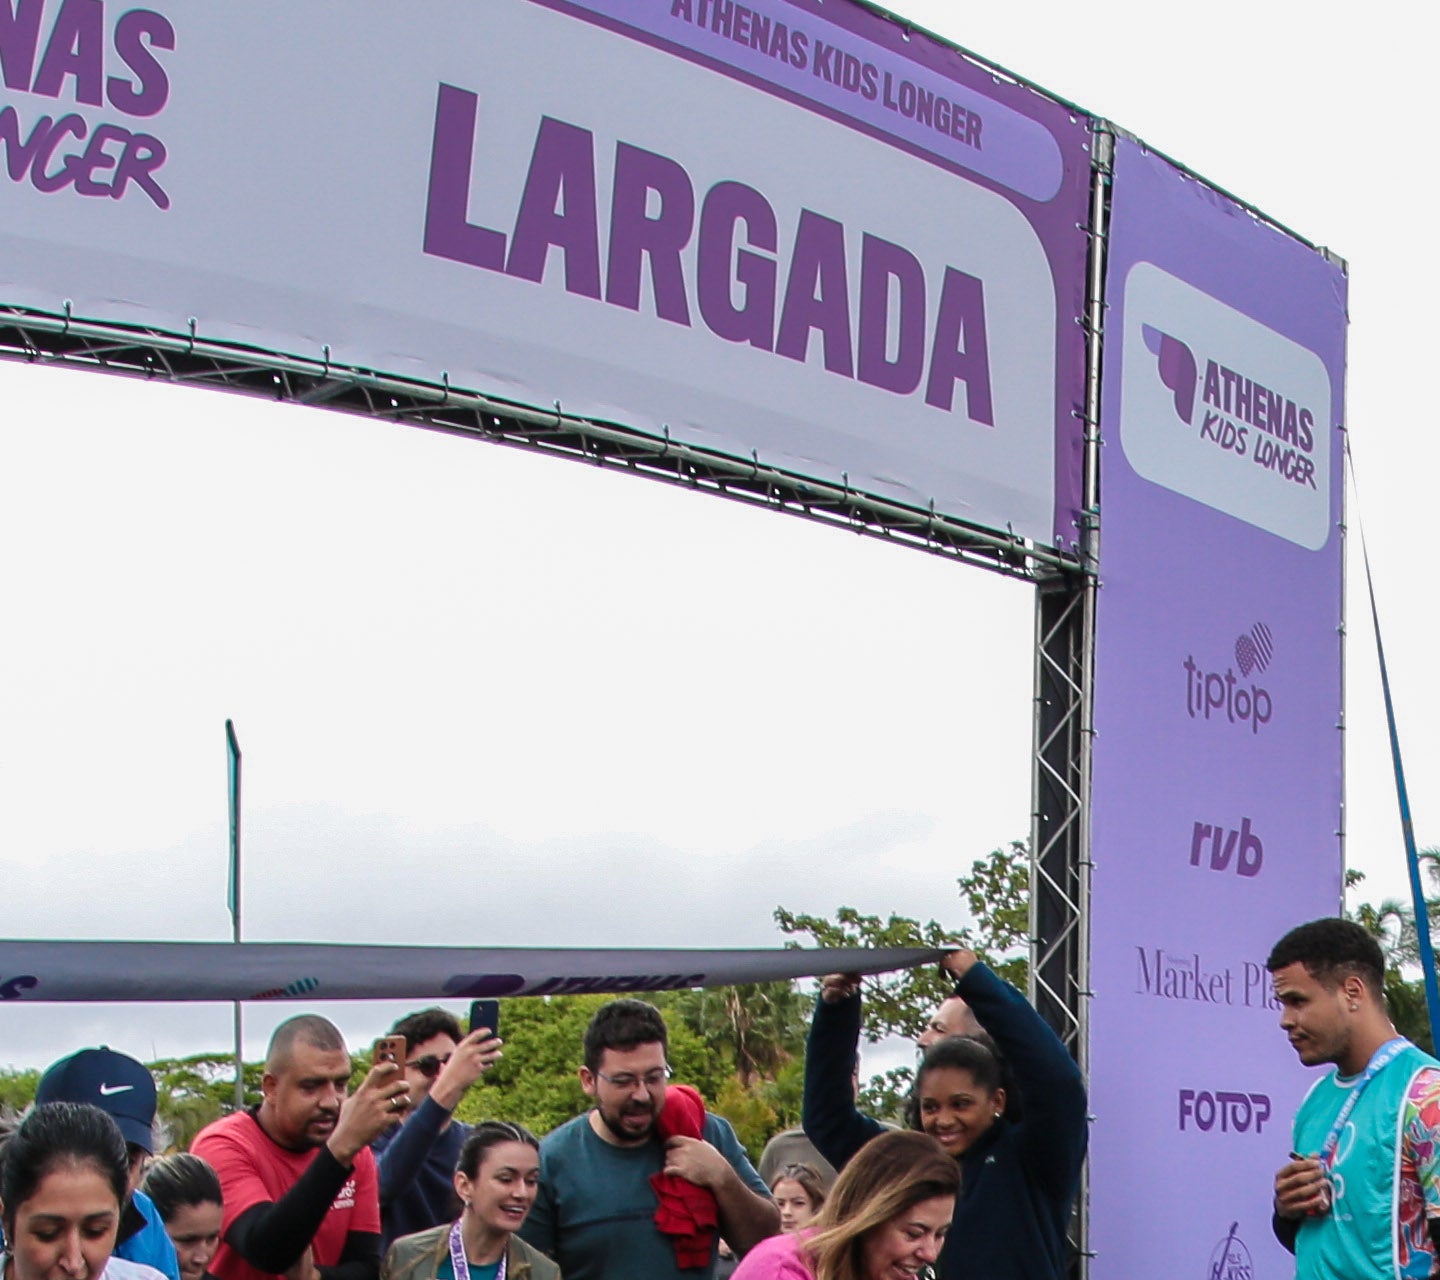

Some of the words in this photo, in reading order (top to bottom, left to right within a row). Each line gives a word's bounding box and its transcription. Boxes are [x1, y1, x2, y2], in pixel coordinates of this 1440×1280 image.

[670, 0, 809, 70] ATHENAS
[812, 39, 880, 102] KIDS
[882, 72, 984, 150] LONGER
[422, 82, 995, 428] LARGADA
[1202, 358, 1314, 453] ATHENAS
[1200, 409, 1250, 456] KIDS
[1253, 433, 1317, 490] LONGER
[1183, 655, 1273, 734] tiptop
[1135, 946, 1233, 1005] Market
[1179, 1089, 1271, 1133] FOTOP
